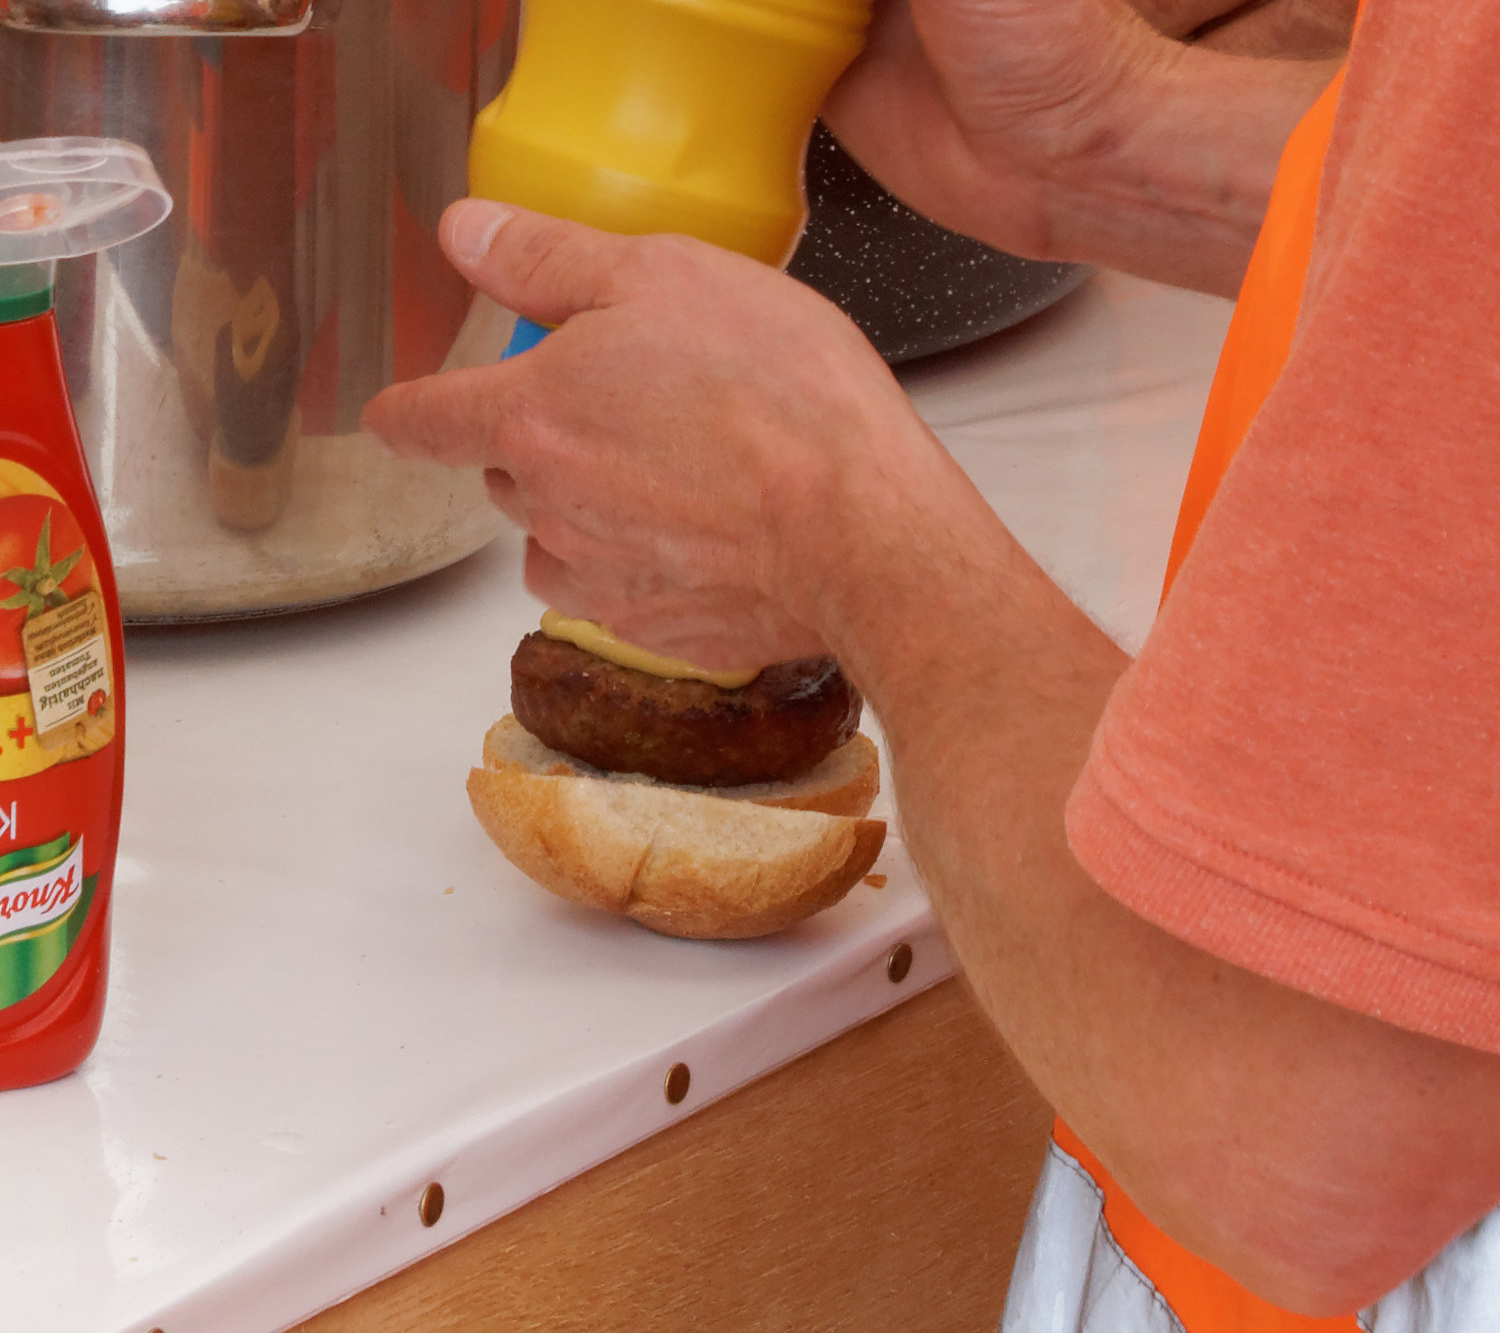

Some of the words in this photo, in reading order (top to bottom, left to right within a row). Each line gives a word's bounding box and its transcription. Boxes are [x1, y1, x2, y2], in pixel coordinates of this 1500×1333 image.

[43, 659, 98, 693] angebauten
[49, 651, 92, 678] Tomaten
[39, 668, 104, 711] nachhaltig
[67, 695, 85, 711] Mit
